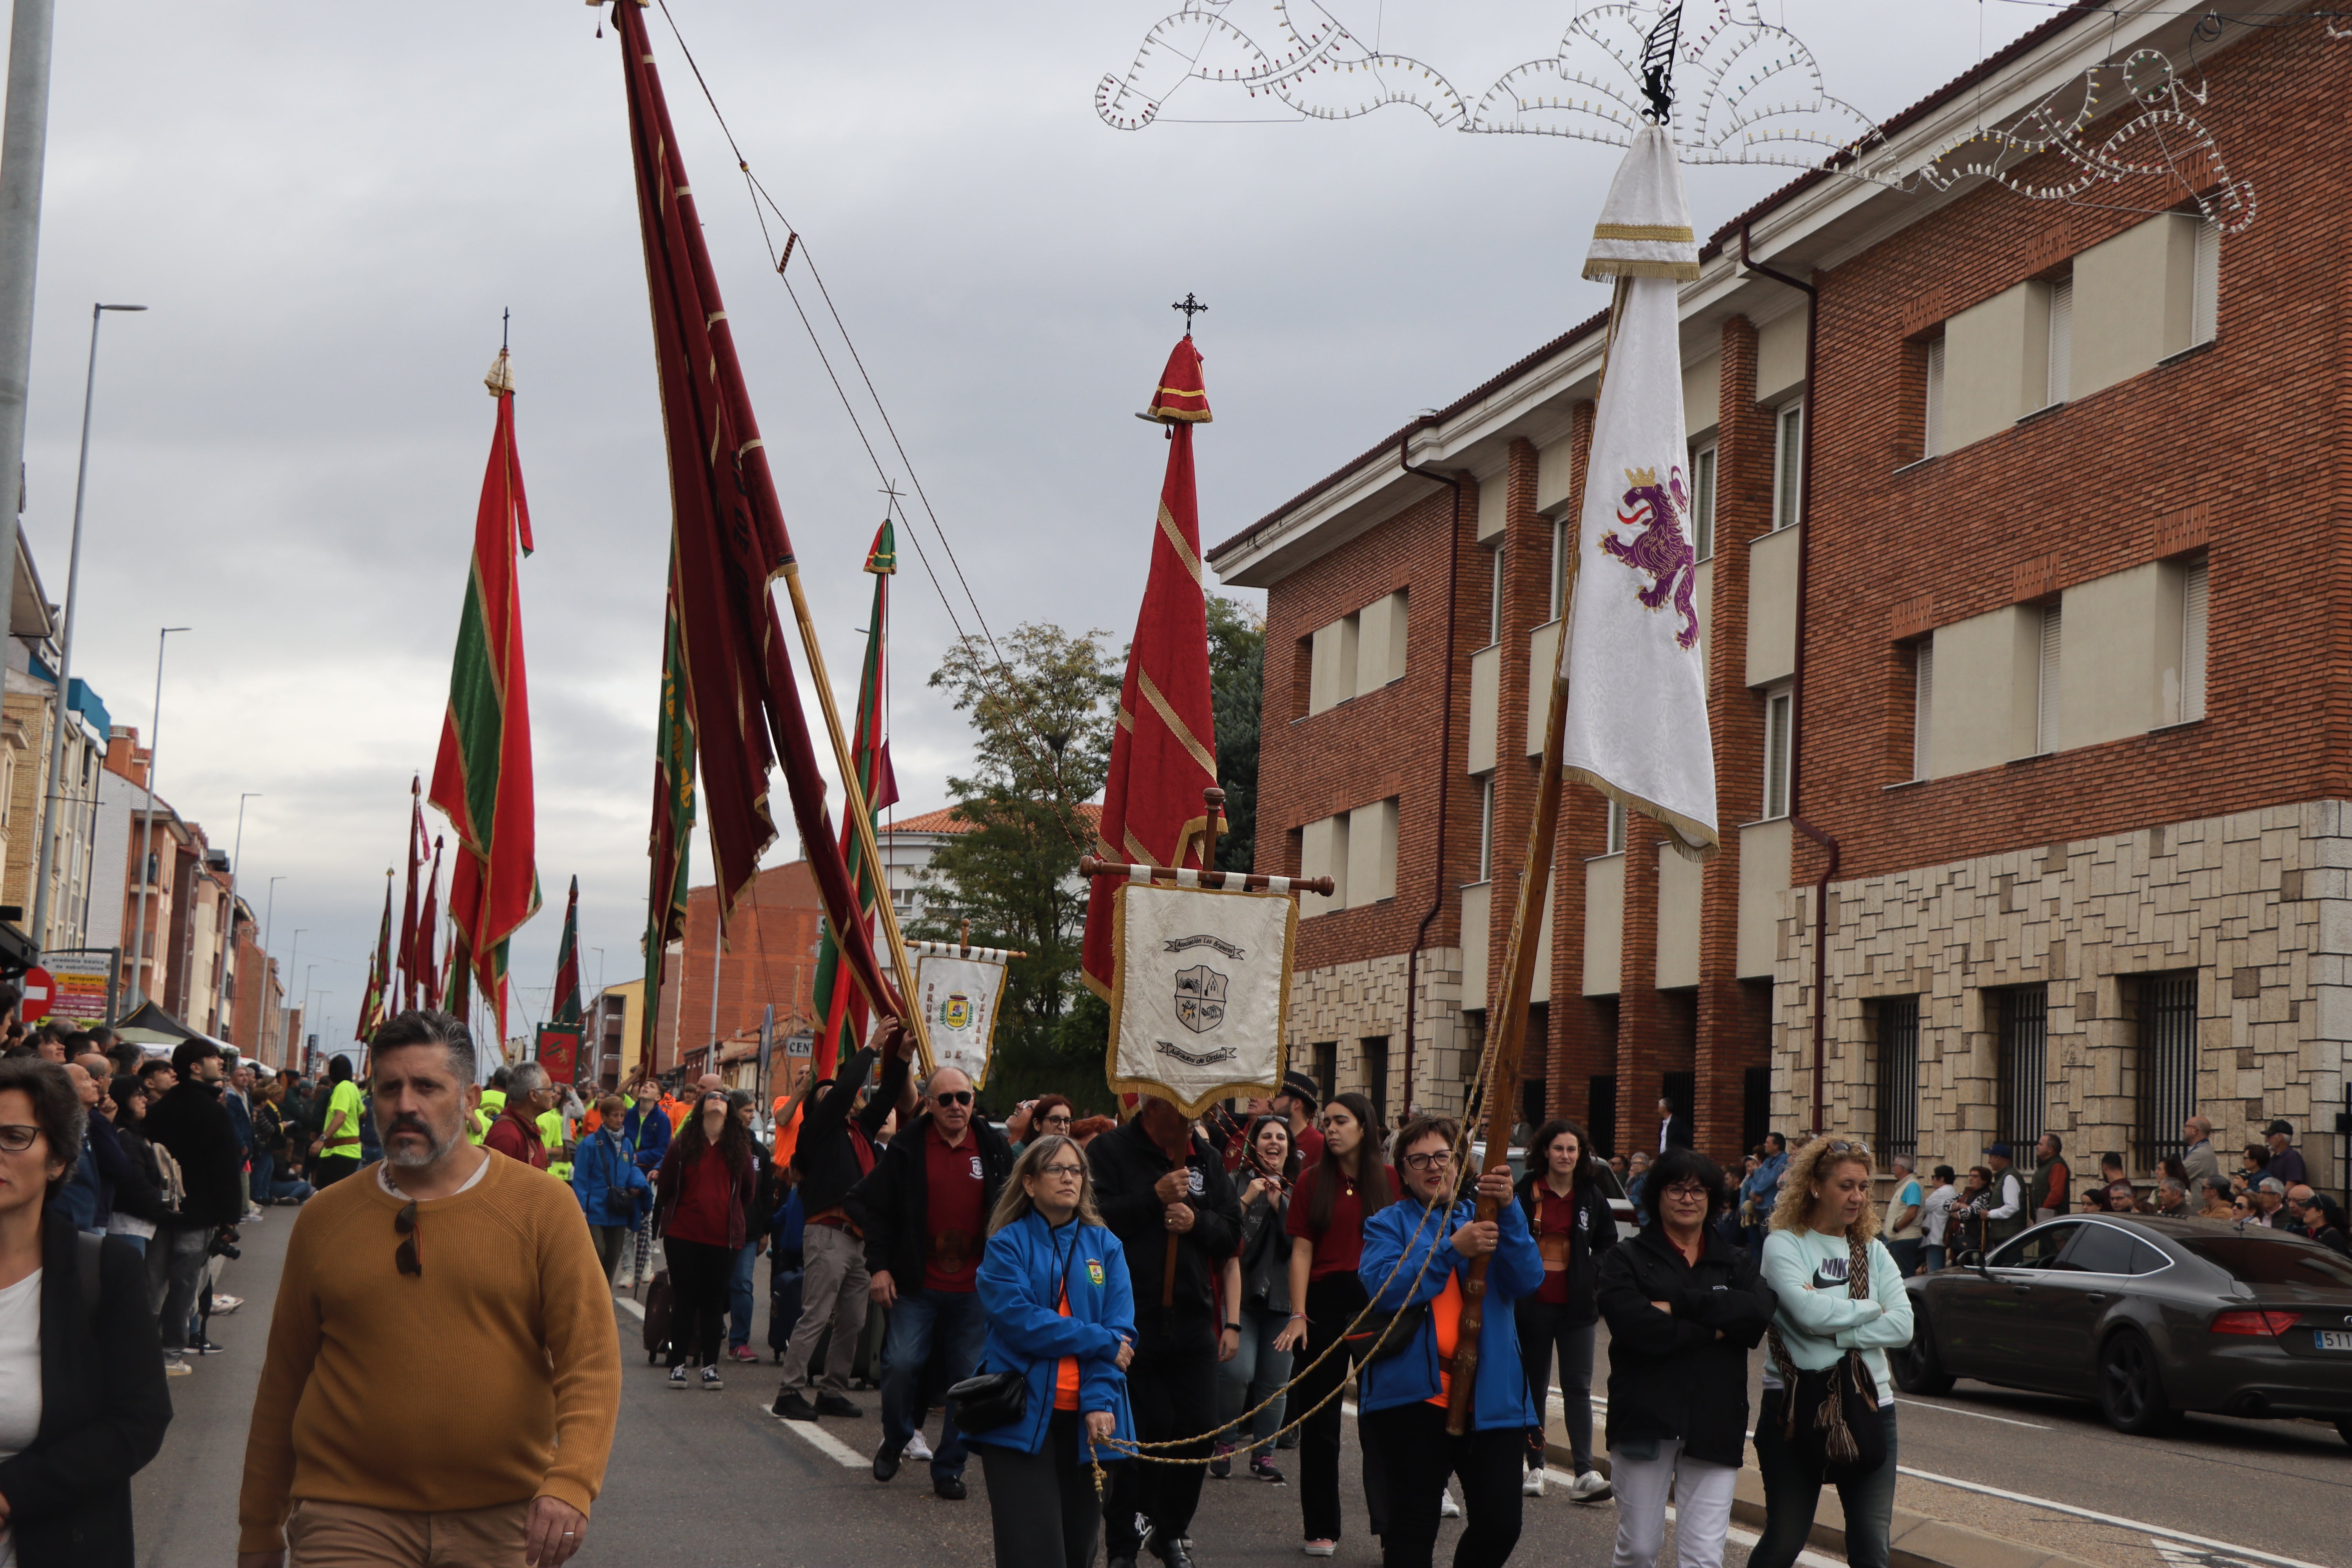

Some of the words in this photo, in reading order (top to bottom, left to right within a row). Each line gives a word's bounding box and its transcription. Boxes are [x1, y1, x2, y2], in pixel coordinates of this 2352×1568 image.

[1176, 937, 1201, 947] Asociación
[1213, 941, 1233, 953] Bruneros
[925, 983, 935, 1041] BRUGO
[975, 993, 987, 1044] FENAR
[789, 1042, 813, 1053] CEN
[945, 1050, 962, 1059] DE
[1168, 1048, 1195, 1063] Adrados
[1206, 1052, 1225, 1062] Ordás
[1821, 1257, 1849, 1279] NIK
